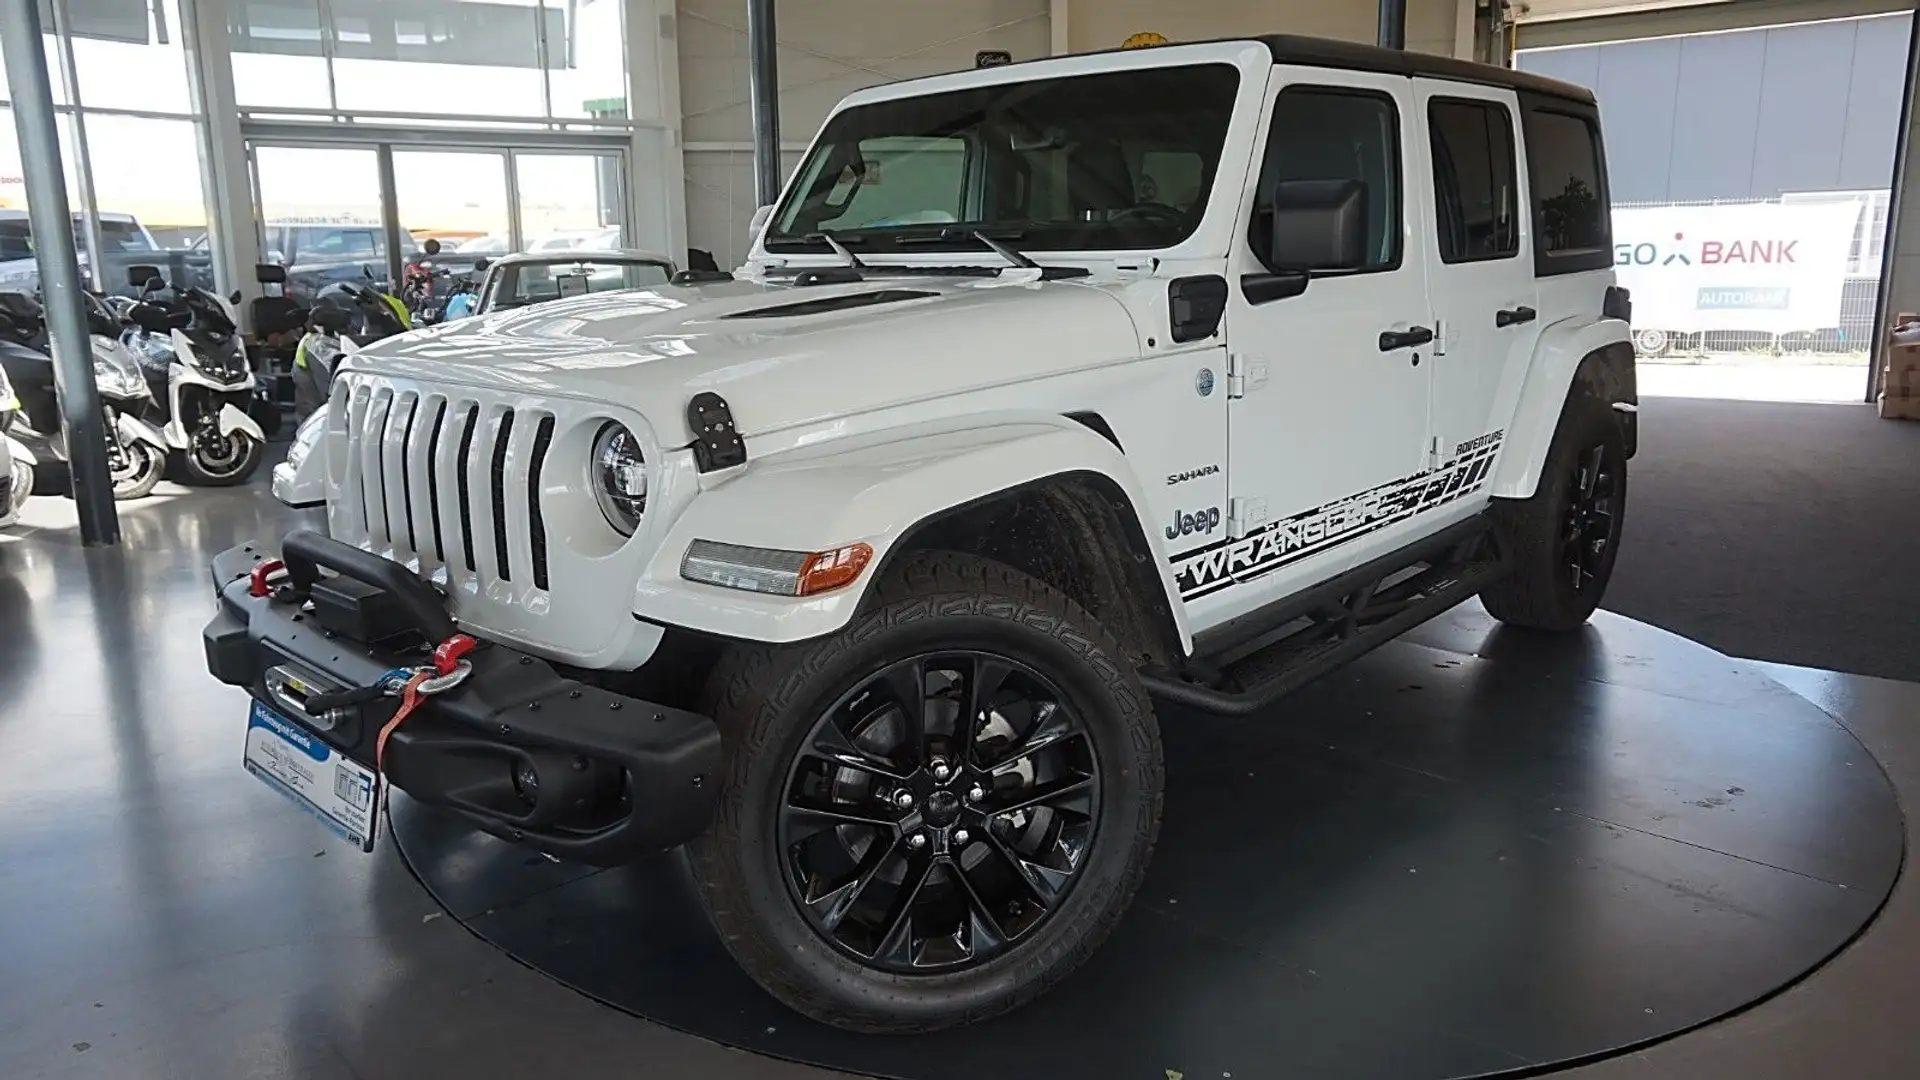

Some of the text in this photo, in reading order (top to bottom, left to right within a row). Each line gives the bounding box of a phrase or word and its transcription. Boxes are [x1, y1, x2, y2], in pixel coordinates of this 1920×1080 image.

[1701, 240, 1798, 264] BANK
[1456, 429, 1504, 455] ADVENTURE
[1167, 465, 1220, 485] SAHARA
[1165, 507, 1220, 539] Jeep
